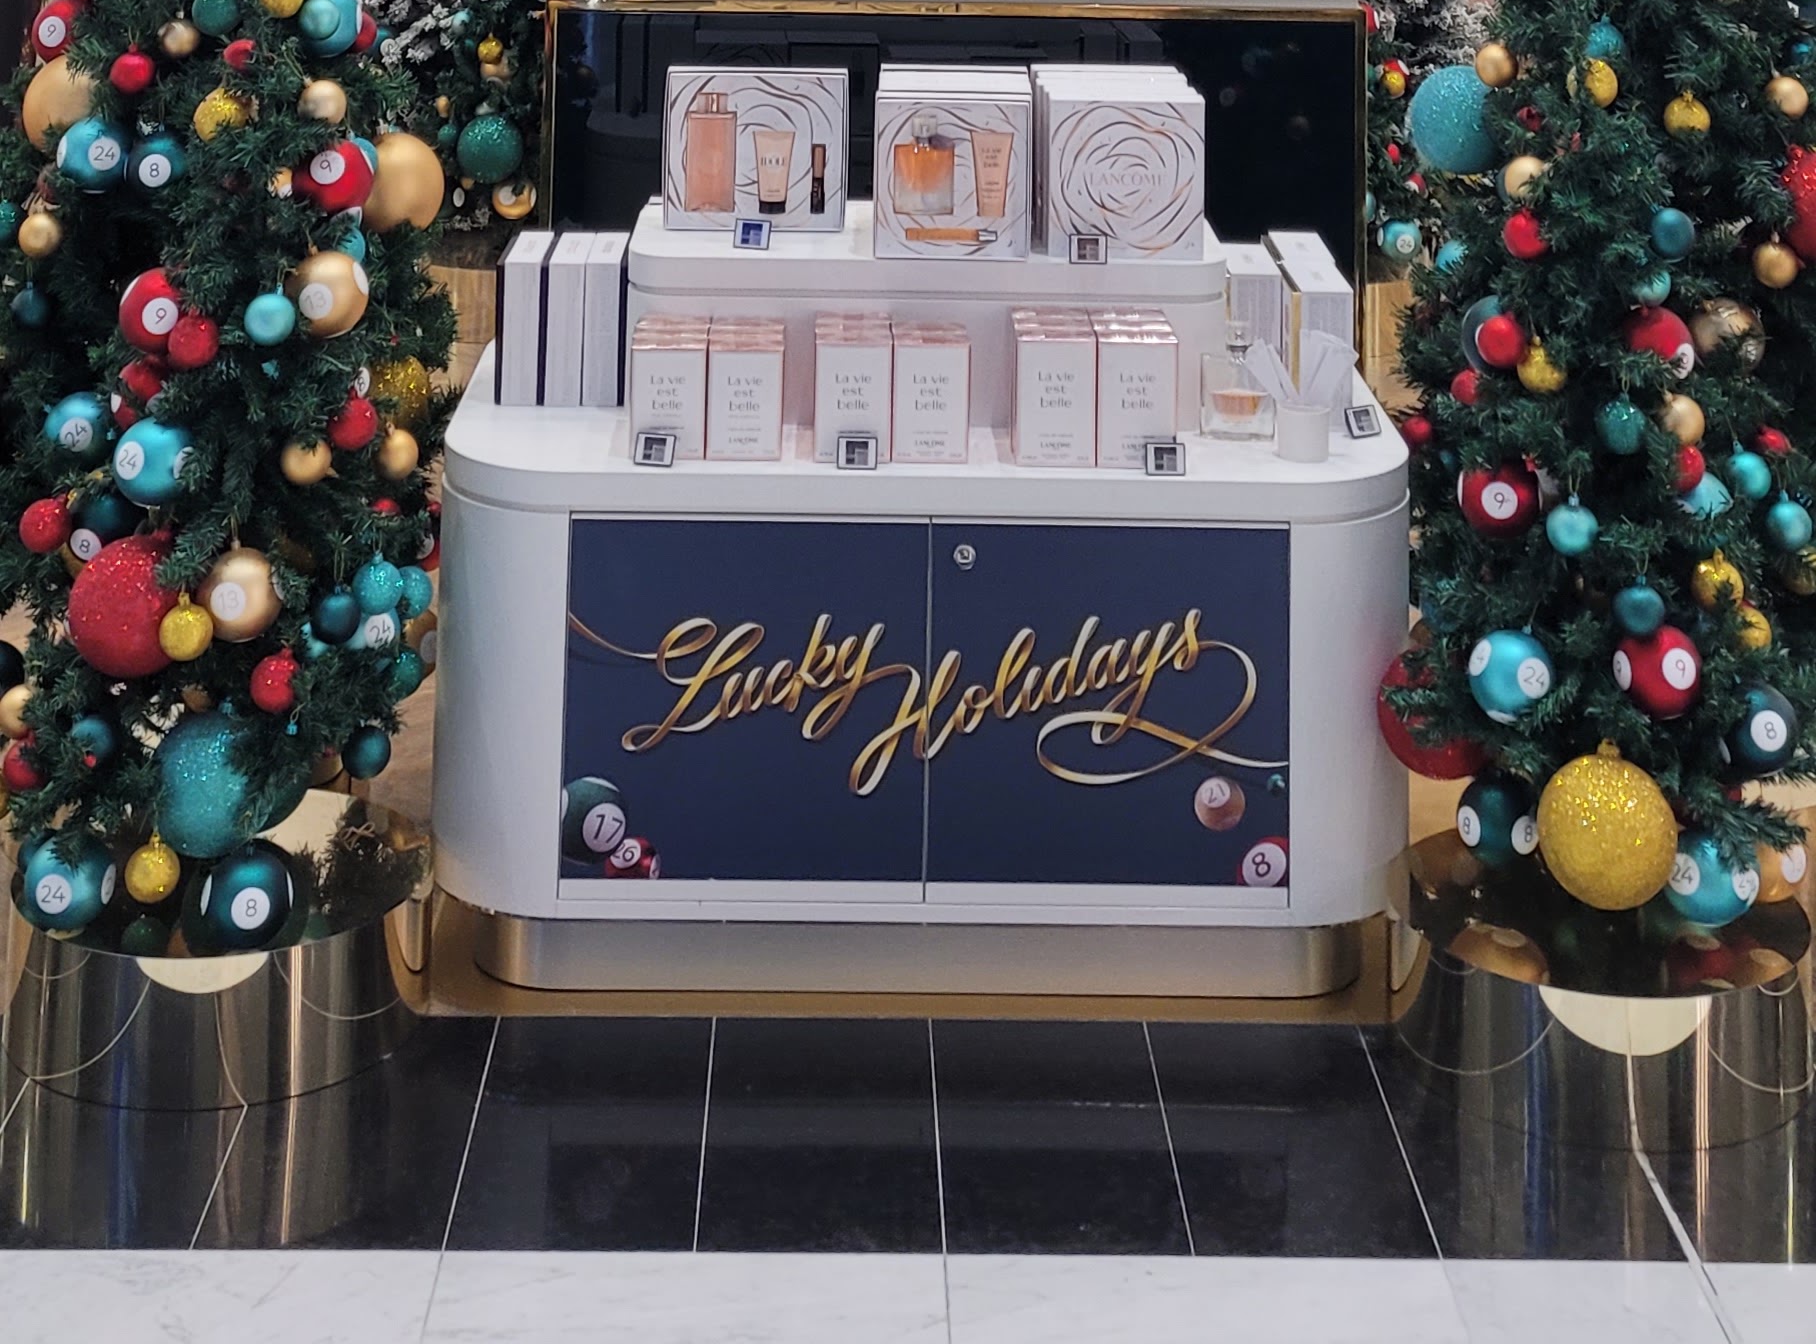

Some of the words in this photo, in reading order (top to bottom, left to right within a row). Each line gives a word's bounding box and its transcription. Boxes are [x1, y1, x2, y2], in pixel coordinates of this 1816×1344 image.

[47, 24, 56, 37] 9
[93, 146, 115, 161] 24
[149, 163, 159, 178] 8
[320, 159, 332, 173] 9
[1400, 239, 1412, 248] 24
[303, 291, 326, 311] 13
[155, 308, 166, 325] 9
[650, 376, 664, 384] La
[668, 376, 686, 385] vie
[728, 376, 741, 385] La
[744, 376, 762, 386] vie
[835, 373, 849, 384] La
[853, 374, 871, 384] vie
[913, 374, 927, 384] La
[931, 374, 949, 384] vie
[1038, 371, 1052, 381] La
[1056, 371, 1074, 382] vie
[1120, 373, 1134, 383] La
[1138, 373, 1156, 383] vie
[357, 377, 365, 391] 8
[1045, 385, 1066, 394] est
[1126, 387, 1147, 395] est
[657, 388, 679, 396] est
[733, 389, 755, 397] est
[842, 387, 864, 396] est
[920, 387, 942, 396] est
[652, 400, 683, 410] belle
[729, 401, 760, 411] belle
[837, 400, 869, 410] belle
[915, 400, 947, 410] belle
[1040, 397, 1072, 408] belle
[1121, 399, 1153, 409] belle
[65, 423, 87, 447] 24
[118, 450, 137, 470] 24
[1494, 493, 1504, 509] 9
[80, 539, 90, 553] 8
[218, 592, 239, 610] 13
[370, 621, 391, 644] 24
[1676, 659, 1685, 679] 9
[1523, 667, 1545, 690] 24
[622, 614, 886, 752] Lucky
[848, 608, 1202, 796] Holidays
[1764, 722, 1776, 740] 8
[1205, 783, 1226, 804] 21
[594, 814, 623, 843] 17
[1462, 817, 1471, 834] 8
[1524, 825, 1533, 843] 8
[612, 843, 638, 862] 26
[1252, 852, 1271, 877] 8
[1671, 863, 1694, 885] 24
[40, 885, 66, 904] 24
[245, 899, 257, 917] 8
